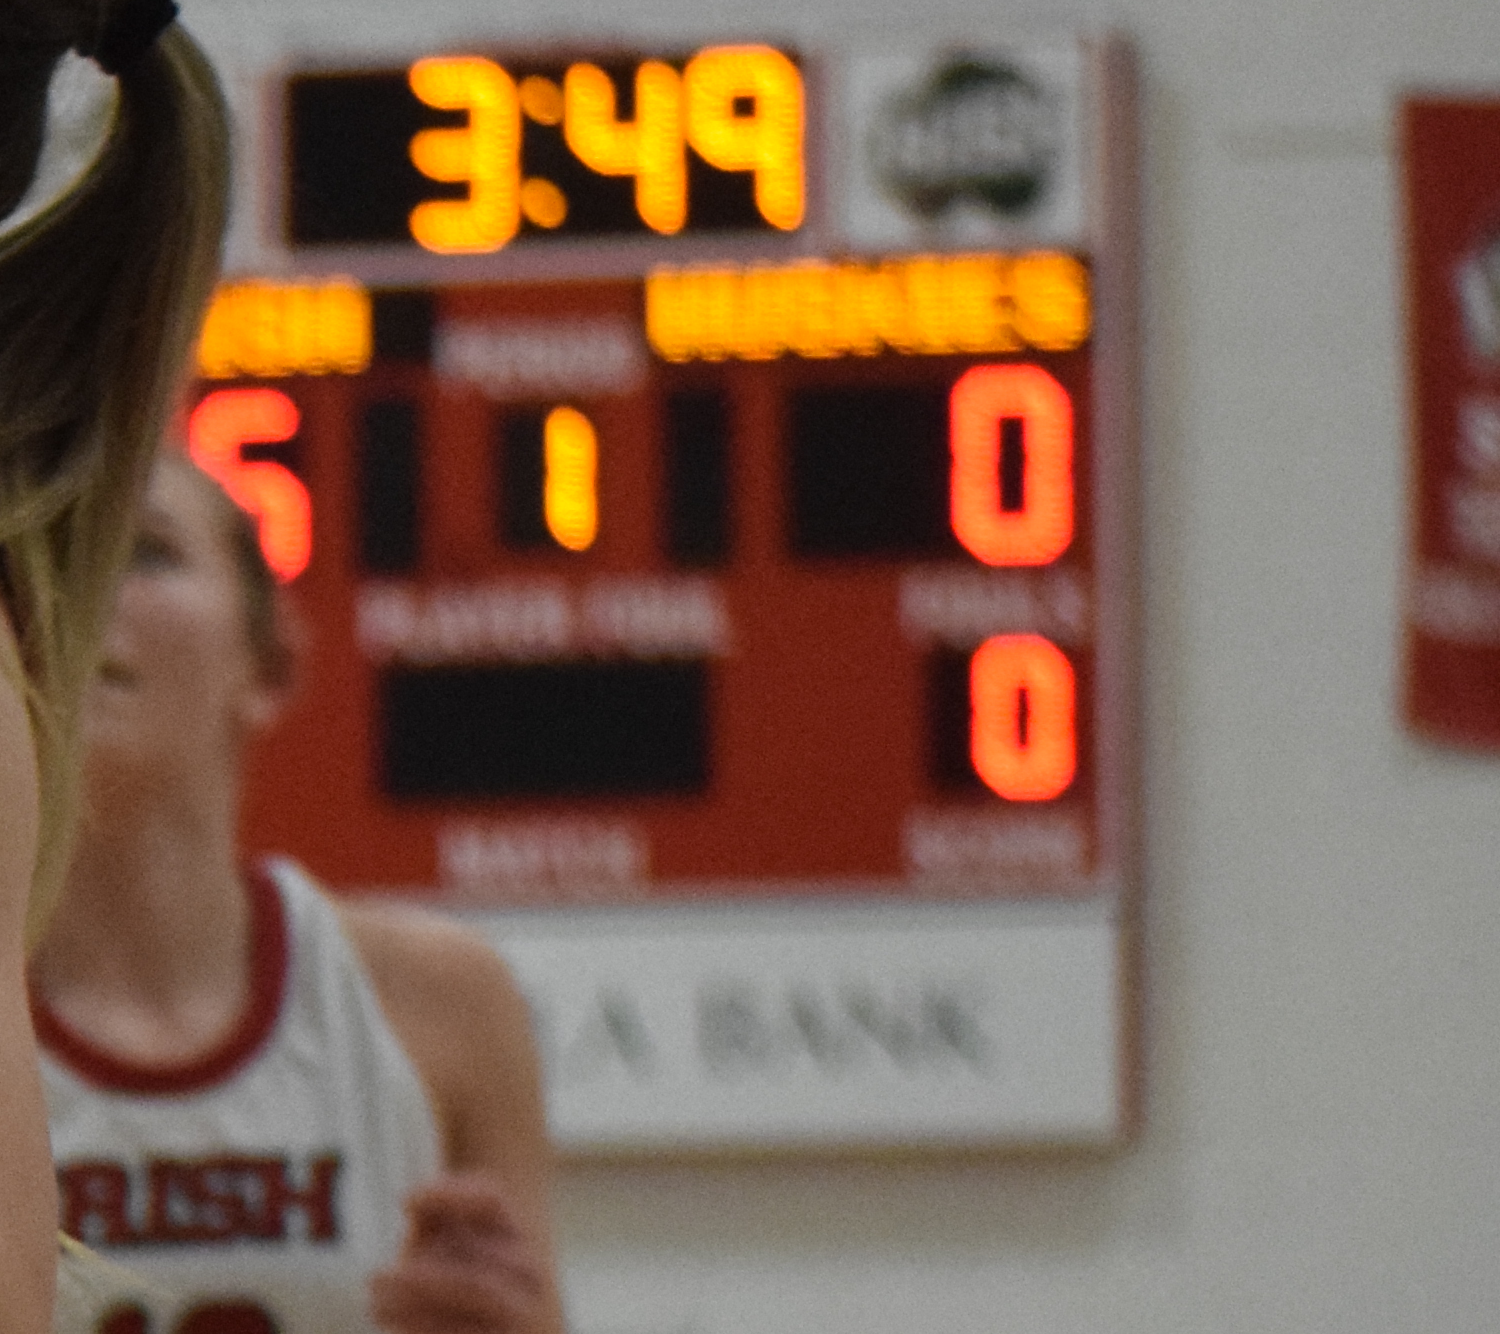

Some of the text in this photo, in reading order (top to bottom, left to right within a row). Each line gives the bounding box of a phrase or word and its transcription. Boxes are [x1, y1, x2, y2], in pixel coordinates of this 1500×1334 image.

[406, 41, 808, 257] 3:49
[644, 251, 1094, 363] HUSKIES
[948, 363, 1076, 569] 0
[966, 631, 1080, 805] 0
[56, 1153, 344, 1251] RISH
